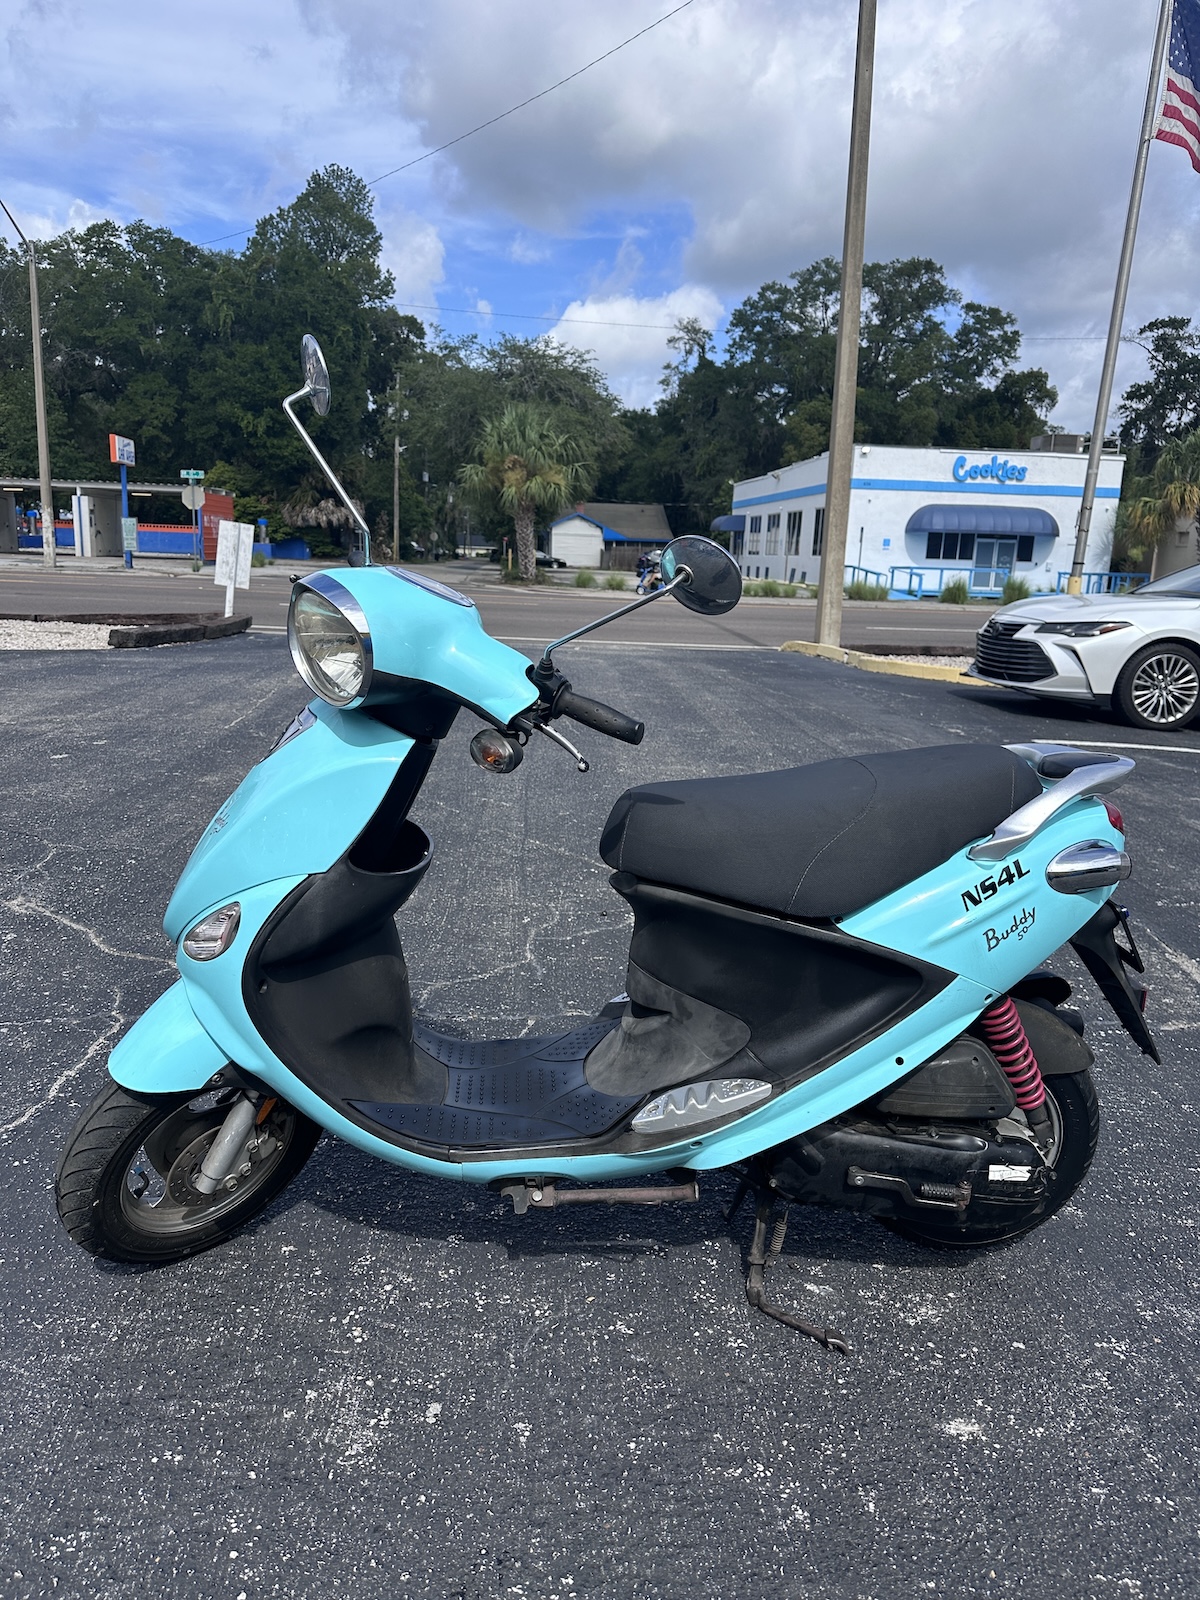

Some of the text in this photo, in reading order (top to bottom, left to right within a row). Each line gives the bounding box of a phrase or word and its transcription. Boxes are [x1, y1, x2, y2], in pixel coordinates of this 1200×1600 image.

[953, 455, 1028, 483] Cookies
[961, 859, 1031, 913] NS4L
[982, 906, 1035, 952] Buddy
[1017, 925, 1029, 941] 50
